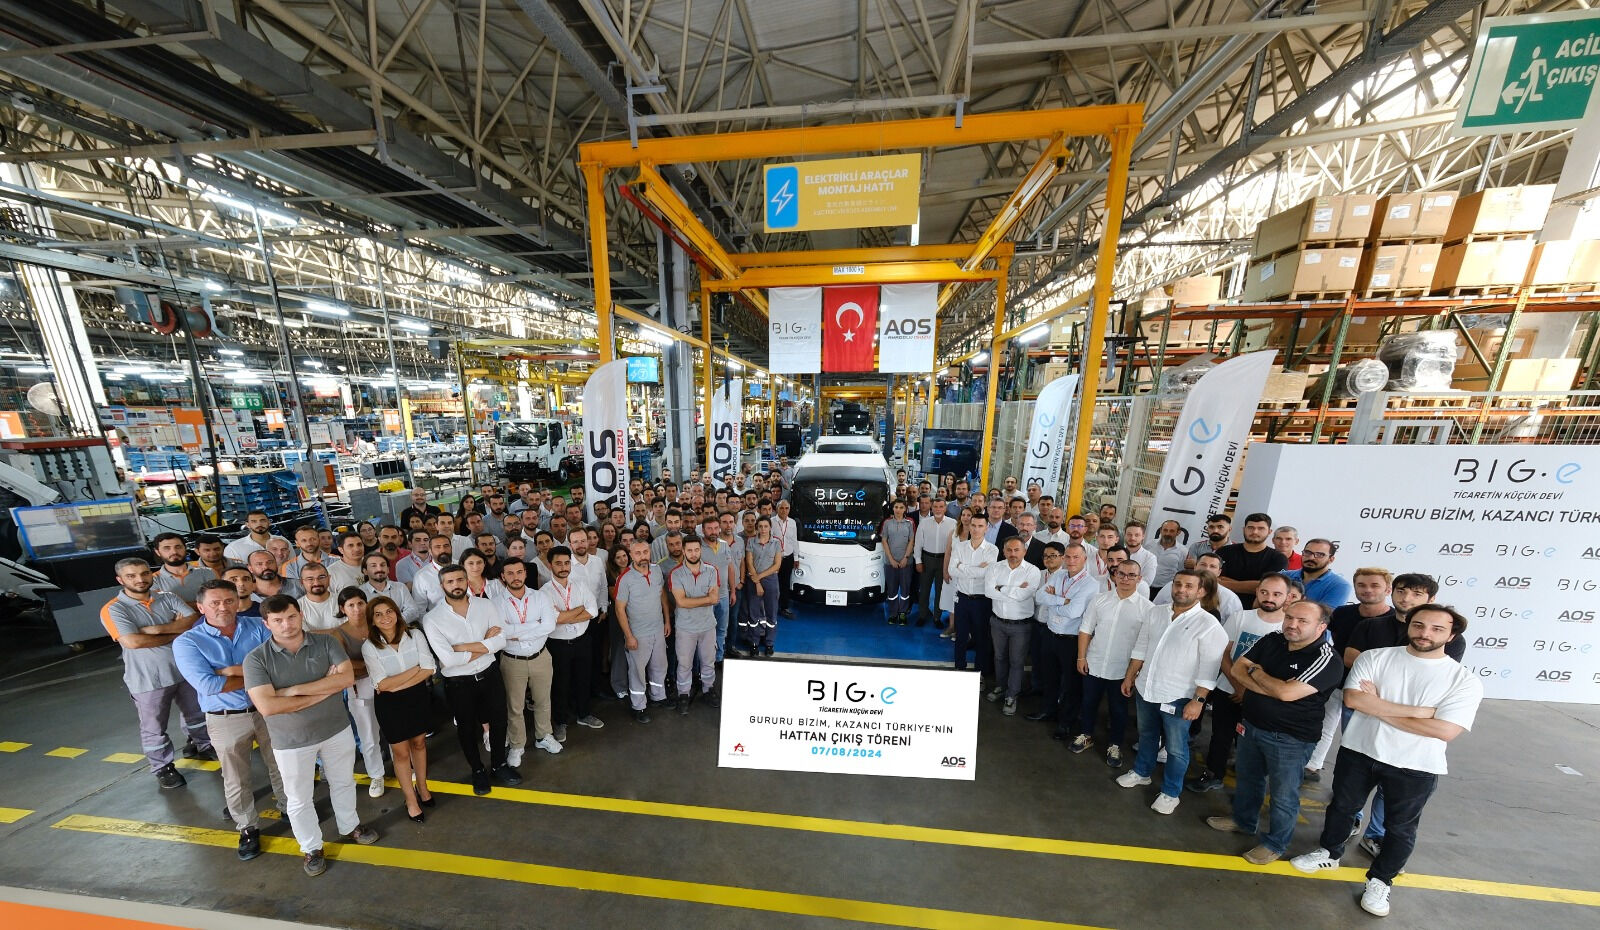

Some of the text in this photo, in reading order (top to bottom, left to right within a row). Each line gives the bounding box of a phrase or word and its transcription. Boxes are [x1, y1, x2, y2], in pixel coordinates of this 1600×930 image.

[1555, 33, 1600, 58] ACİL
[1546, 65, 1598, 89] ÇIKIŞ
[804, 169, 909, 185] ELEKTRİKLİ ARAÇLAR
[818, 182, 894, 196] MONTAJ HATTI
[884, 318, 931, 335] AOS
[233, 398, 245, 407] 13
[247, 398, 260, 407] 13
[713, 422, 733, 482] AOS
[617, 429, 627, 516] NADOLU ISUZU
[1214, 464, 1232, 495] KÜÇÜK
[1225, 440, 1239, 463] DEVİ
[1453, 490, 1564, 501] TİCARETİN KÜÇÜK DEVİ
[1360, 507, 1426, 520] GURURU
[1430, 507, 1476, 522] BİZİM,
[1481, 509, 1554, 522] KAZANCI
[1439, 543, 1475, 554] AOS
[1495, 576, 1532, 587] AOS
[1558, 610, 1595, 621] AOS
[1473, 636, 1509, 647] AOS
[1536, 669, 1572, 681] AOS
[819, 705, 884, 716] TİCARETİN KÜÇÜK DEVİ
[749, 715, 953, 734] GURURU BİZİM, KAZANCI TÜRKİYE'NİN
[779, 730, 912, 747] HATTAN ÇIKIŞ TÖRENİ
[811, 746, 882, 758] 07/08/2024
[941, 756, 966, 766] AOS
